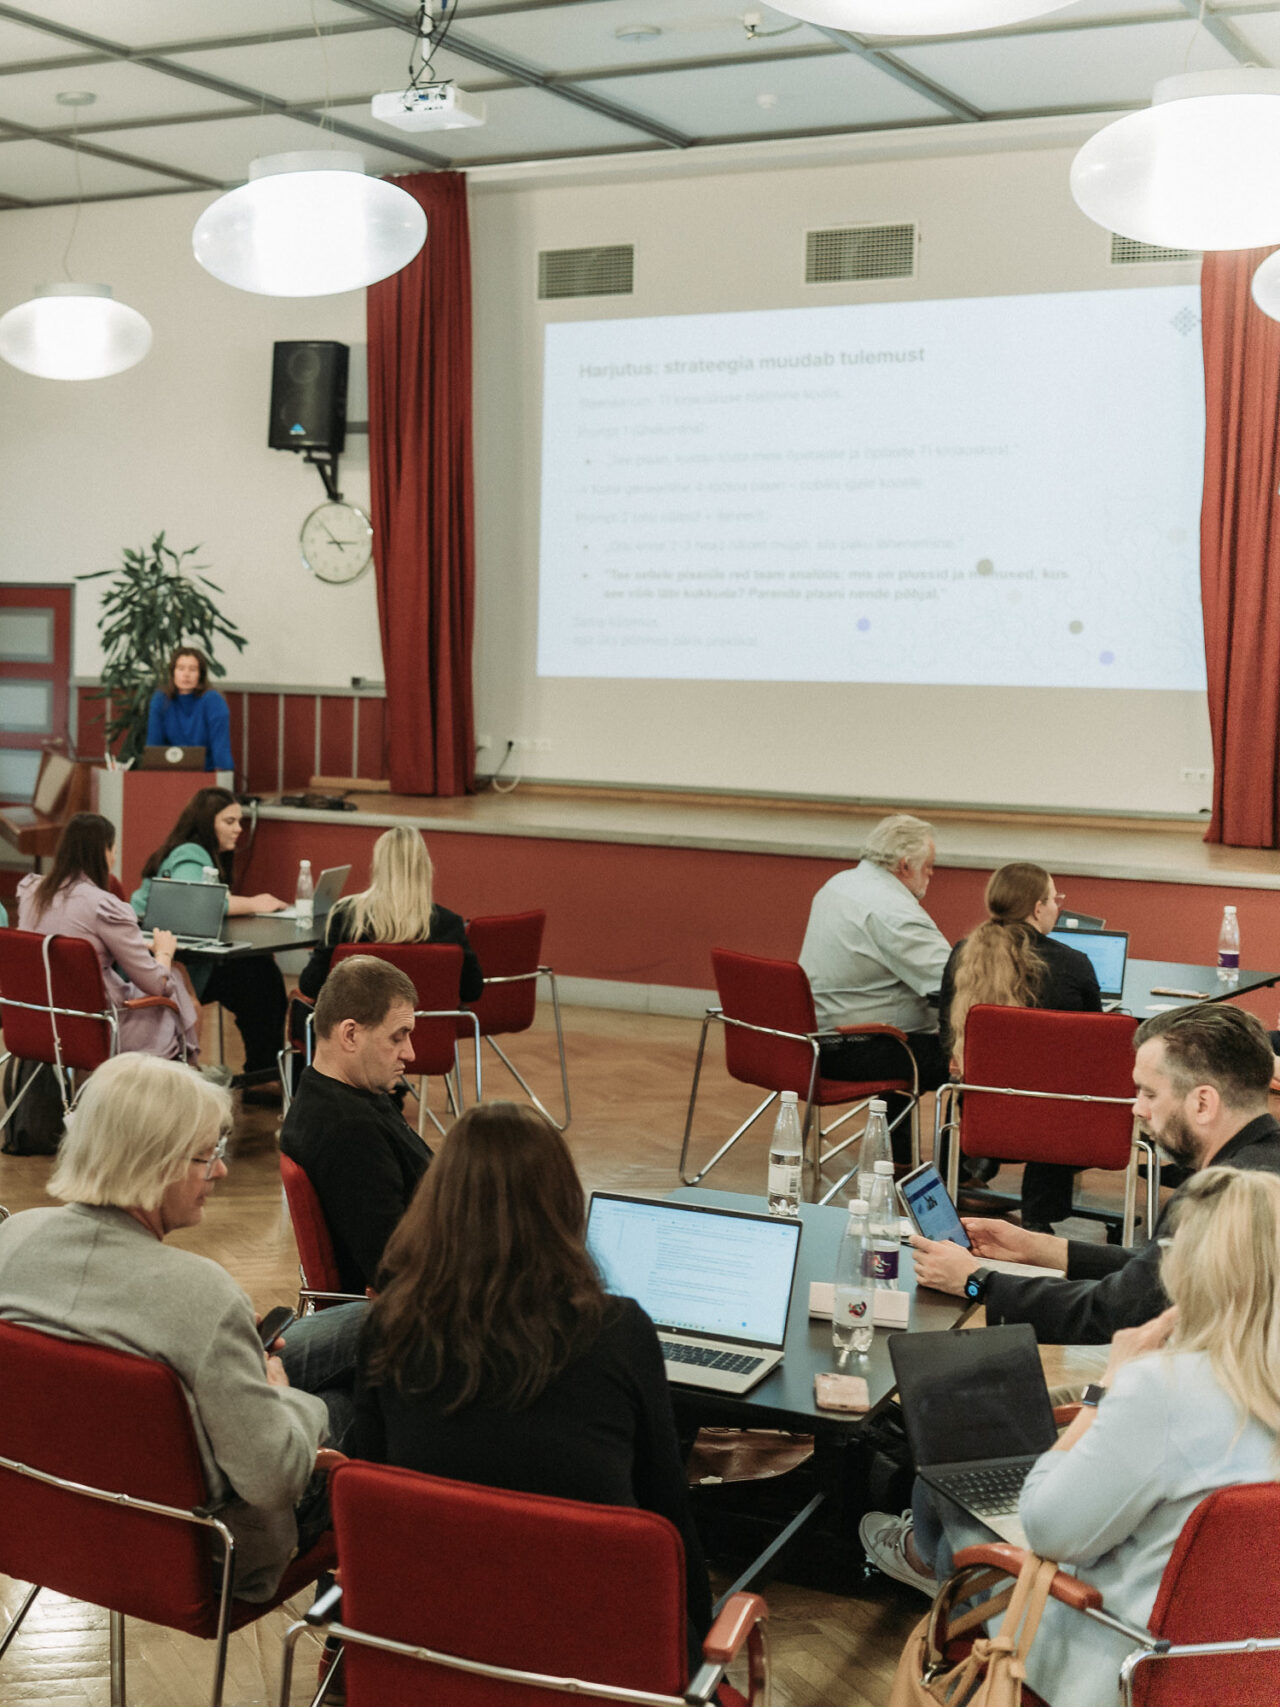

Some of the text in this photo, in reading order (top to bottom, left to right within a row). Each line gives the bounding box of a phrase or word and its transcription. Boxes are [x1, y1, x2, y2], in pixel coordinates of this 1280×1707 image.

[579, 347, 926, 380] Harjutus: strateegia muudab tulemust
